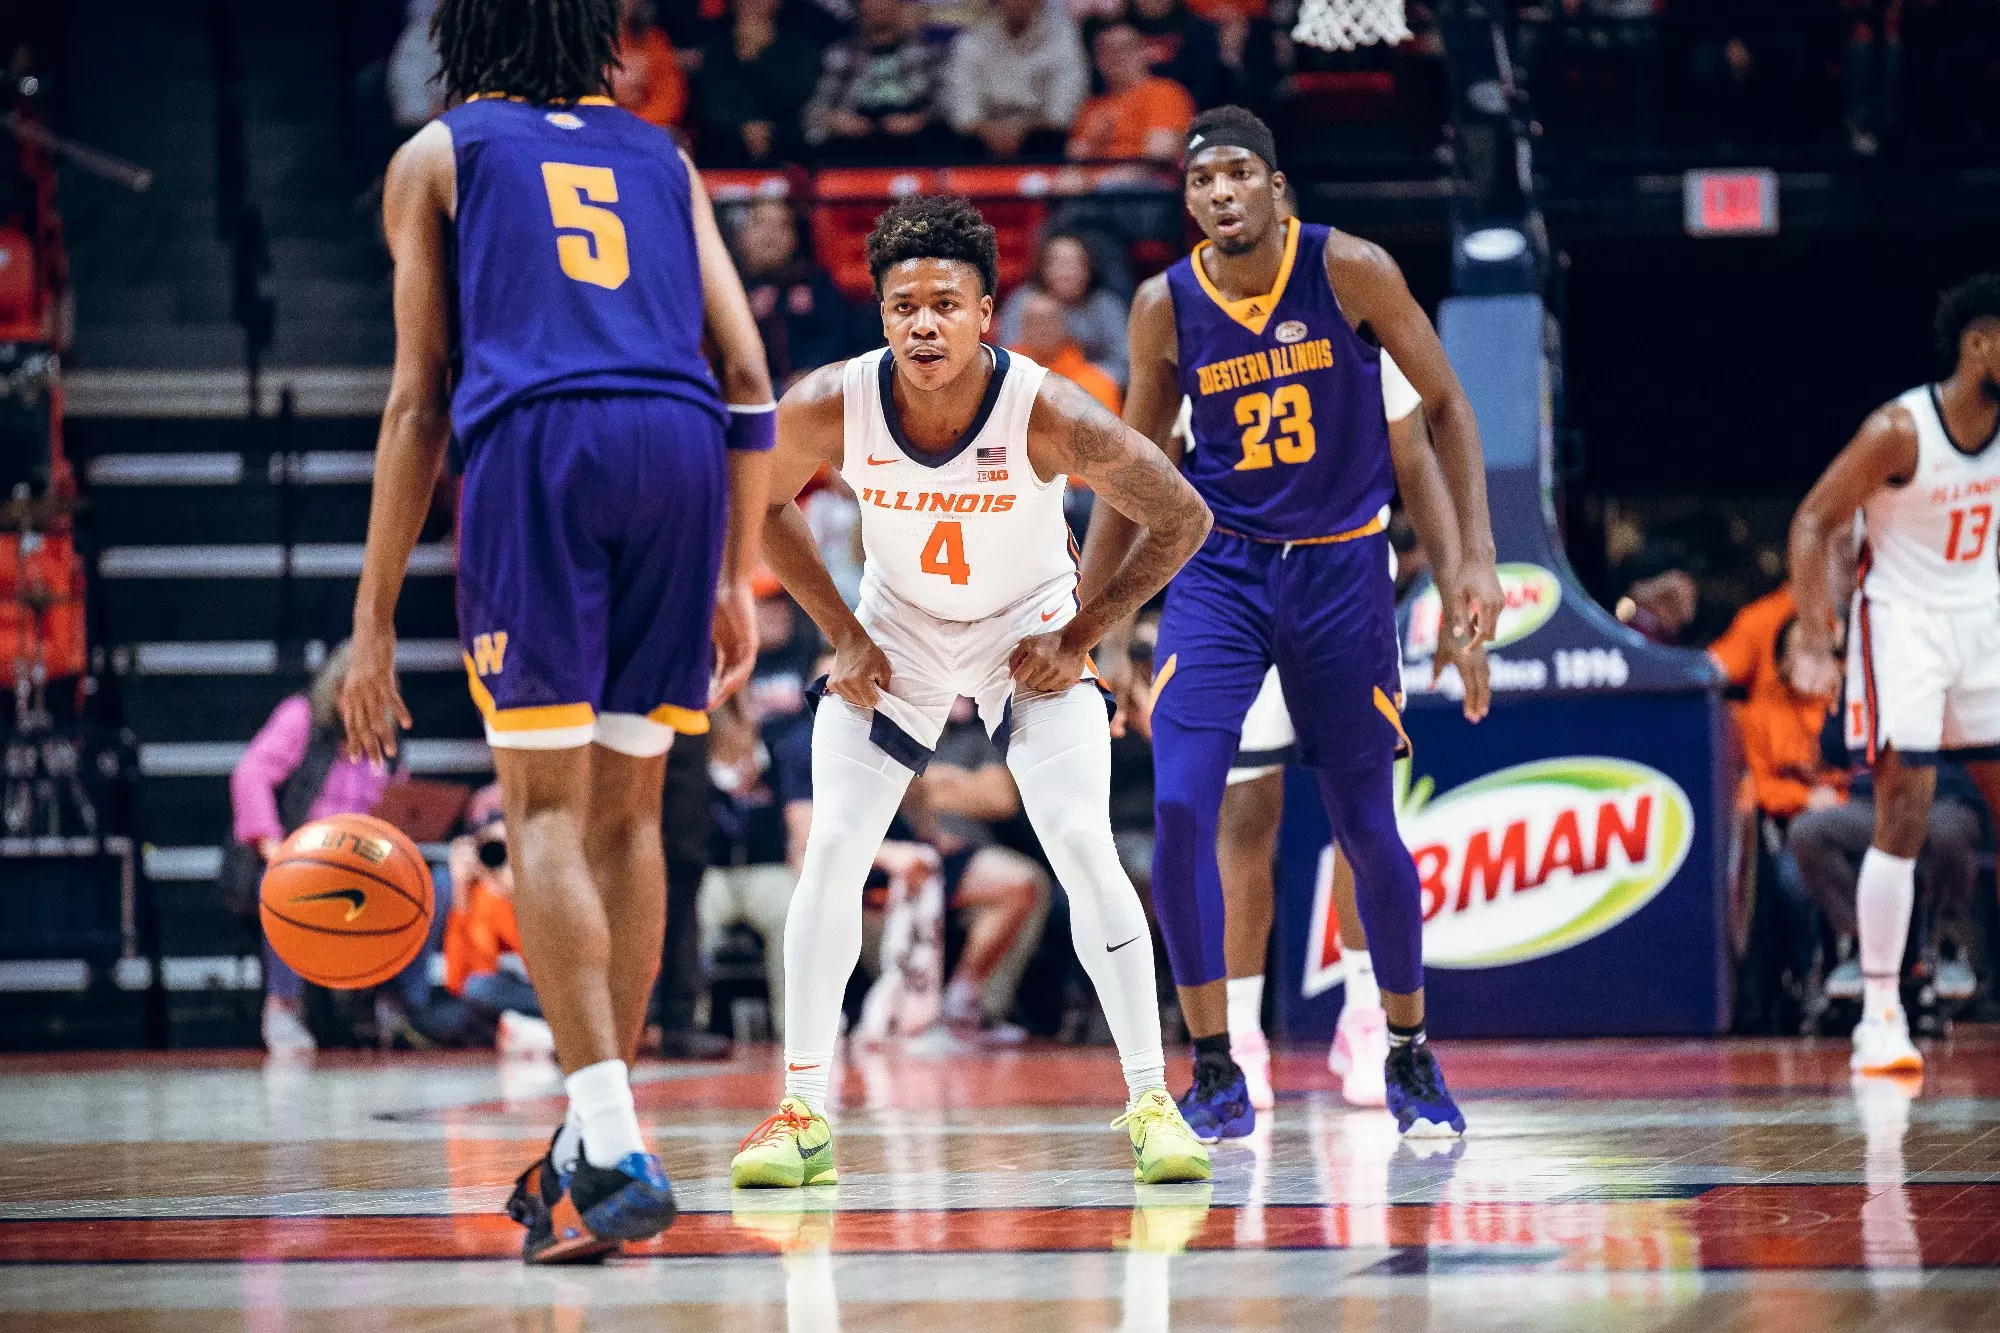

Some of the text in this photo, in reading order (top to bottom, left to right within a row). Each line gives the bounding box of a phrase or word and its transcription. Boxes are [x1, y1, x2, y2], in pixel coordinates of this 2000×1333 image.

[540, 161, 630, 290] 5
[1197, 338, 1334, 396] WESTERN ILLINOIS
[1234, 384, 1316, 471] 23
[862, 487, 1017, 513] ILLINOIS
[920, 521, 970, 585] 4
[1945, 504, 1993, 562] 13
